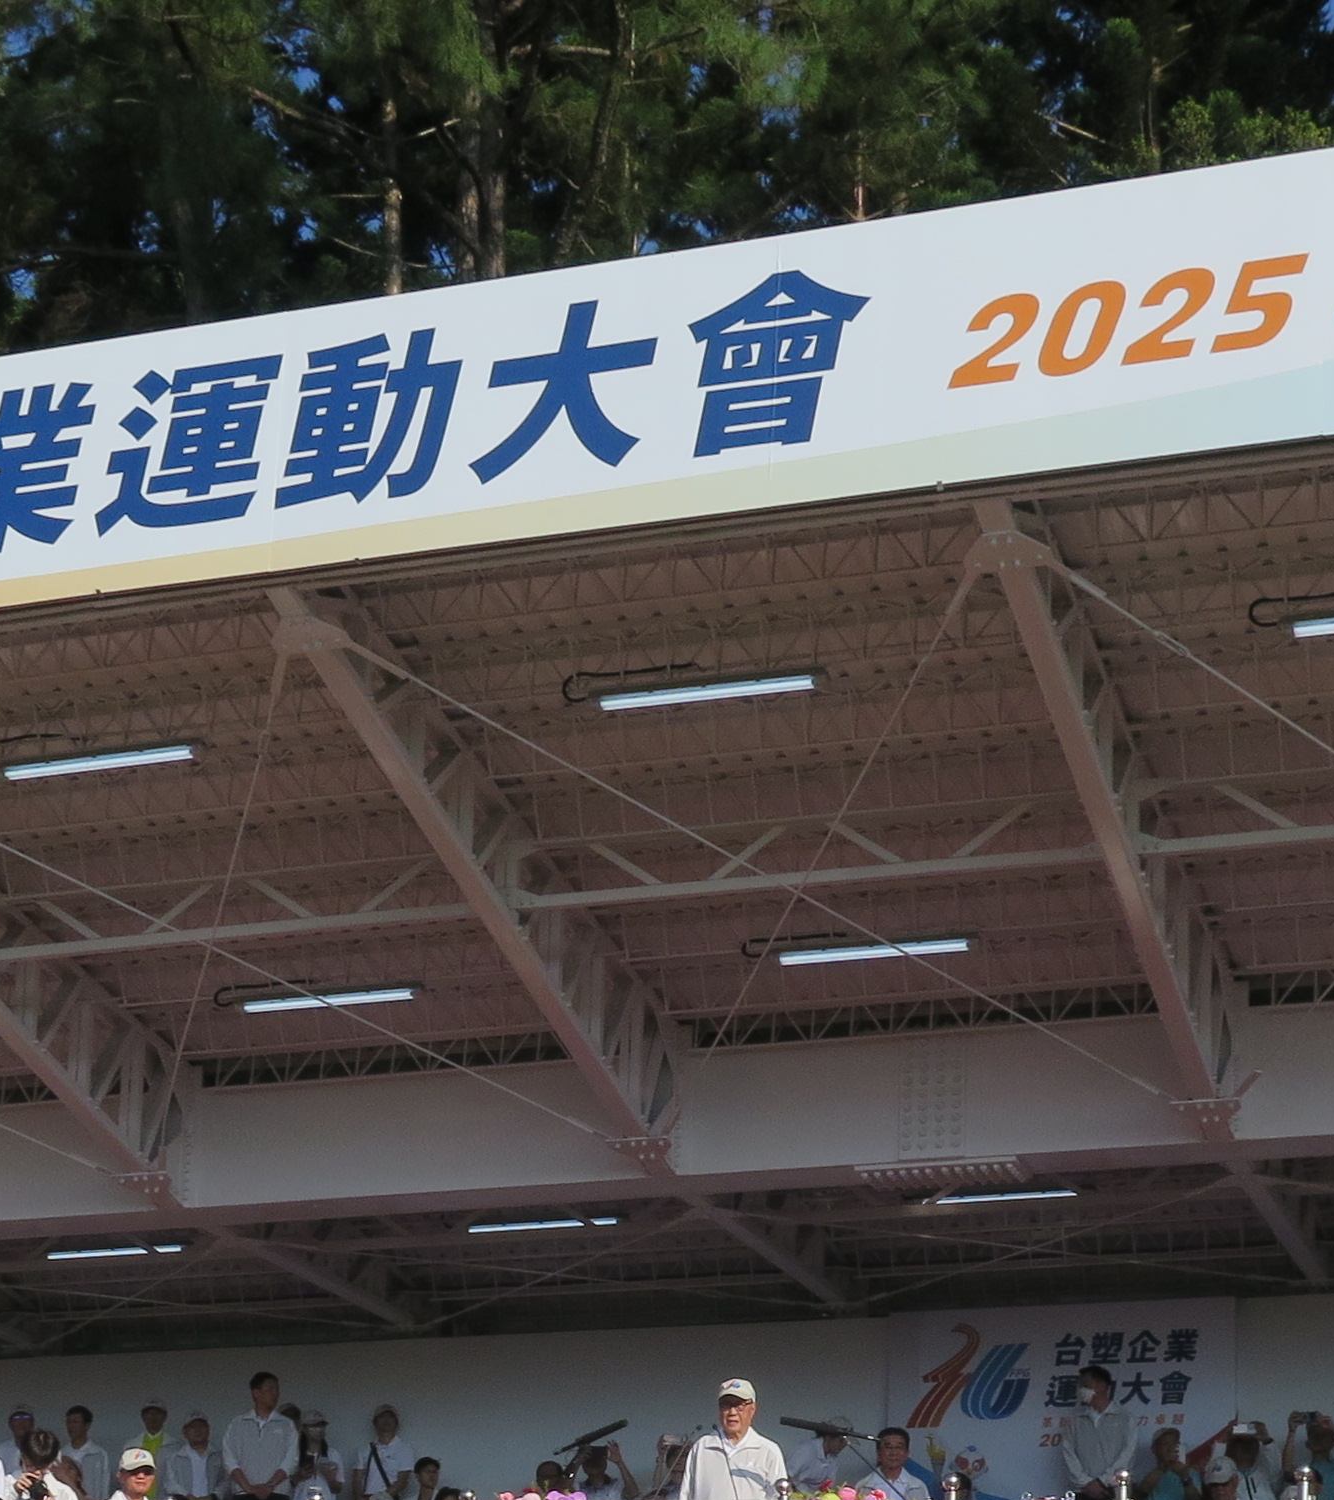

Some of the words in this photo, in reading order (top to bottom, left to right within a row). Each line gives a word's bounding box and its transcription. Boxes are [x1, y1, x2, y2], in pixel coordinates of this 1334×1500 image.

[949, 252, 1309, 389] 2025
[1053, 1328, 1199, 1367] 台塑企業
[1044, 1370, 1193, 1408] 運大會
